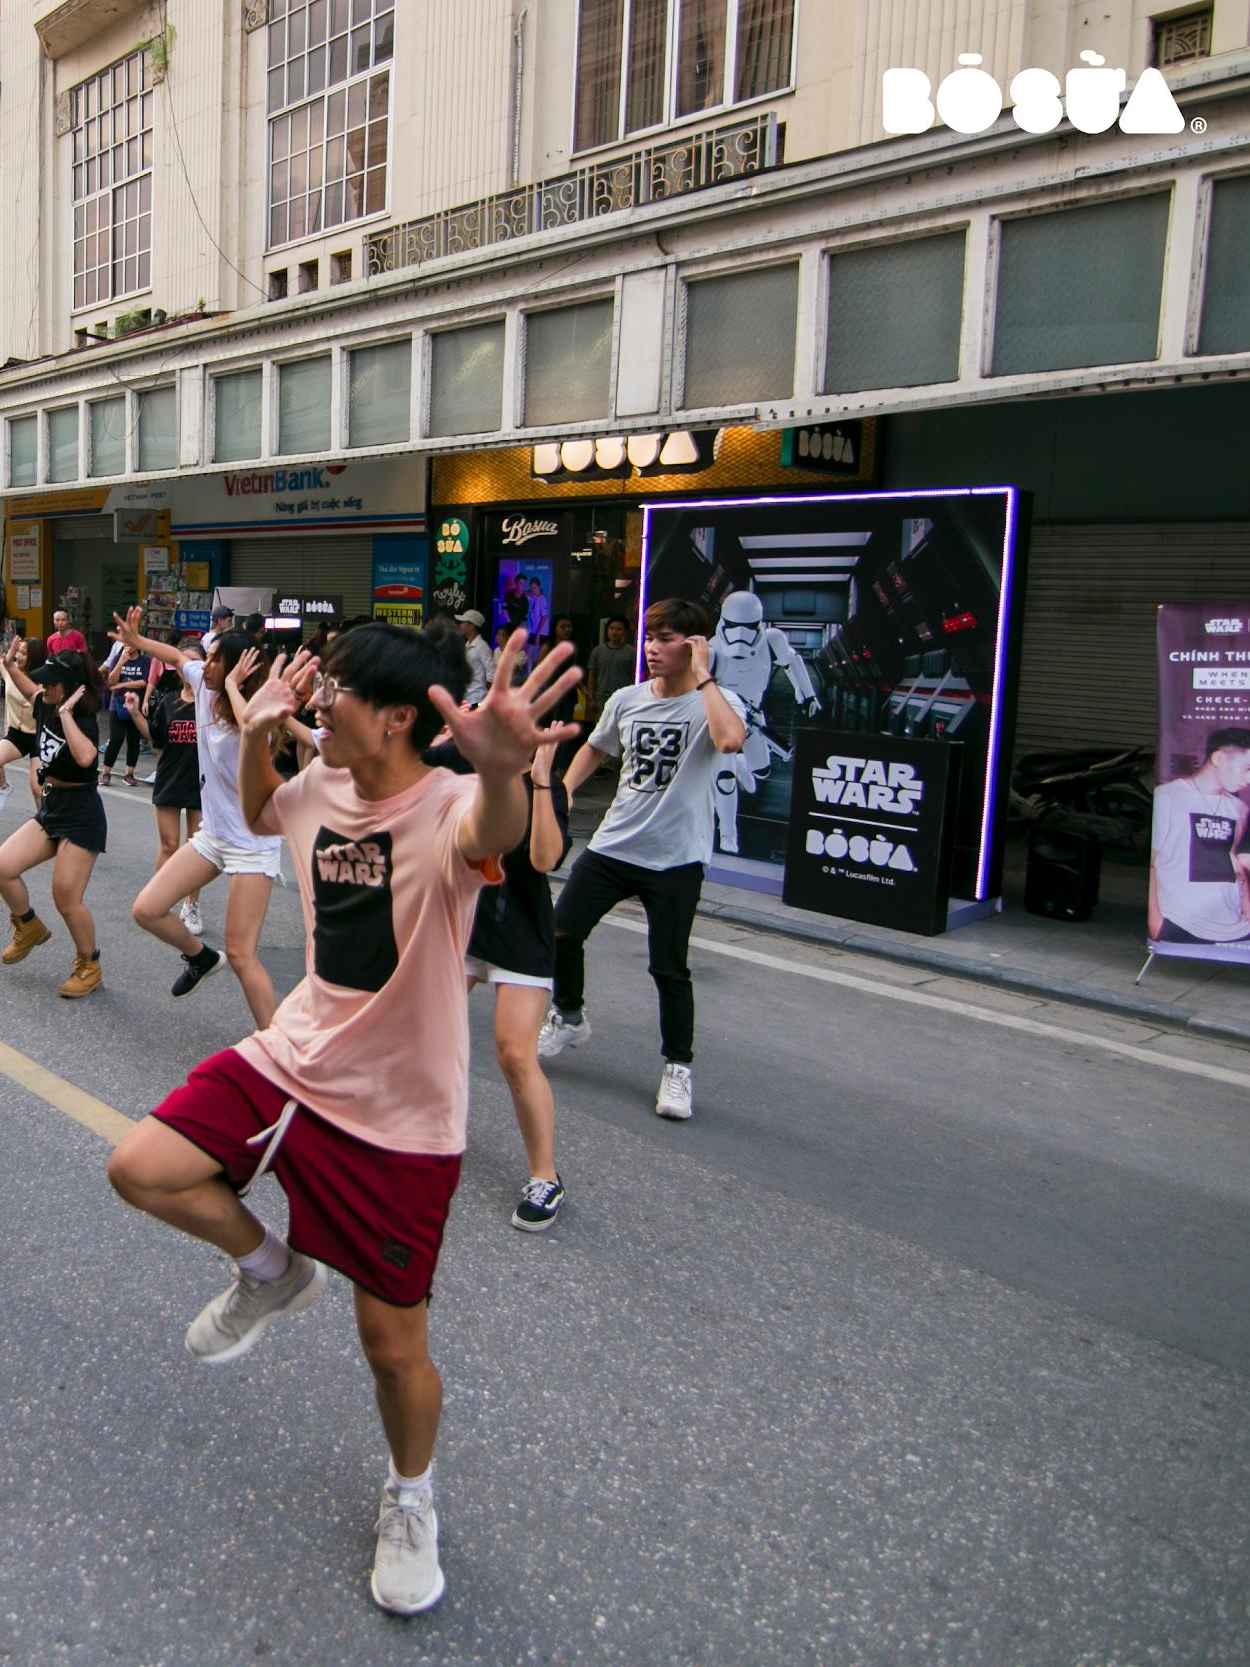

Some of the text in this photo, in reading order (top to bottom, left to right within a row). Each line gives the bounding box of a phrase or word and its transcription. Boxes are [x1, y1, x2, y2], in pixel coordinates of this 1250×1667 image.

[376, 609, 413, 617] WESTERN
[387, 617, 413, 625] UNION
[1205, 619, 1243, 628] STAR
[1206, 624, 1243, 633] WARS
[1169, 649, 1250, 661] CHÍNH TH
[168, 720, 196, 731] STA
[812, 755, 923, 791] STAR
[812, 777, 923, 814] WARS
[1195, 818, 1231, 832] STAR
[1196, 827, 1232, 840] WARS
[316, 842, 385, 864] STAR
[316, 858, 387, 887] WARS
[845, 869, 880, 883] Lucasfilm
[881, 876, 895, 886] Ltd.
